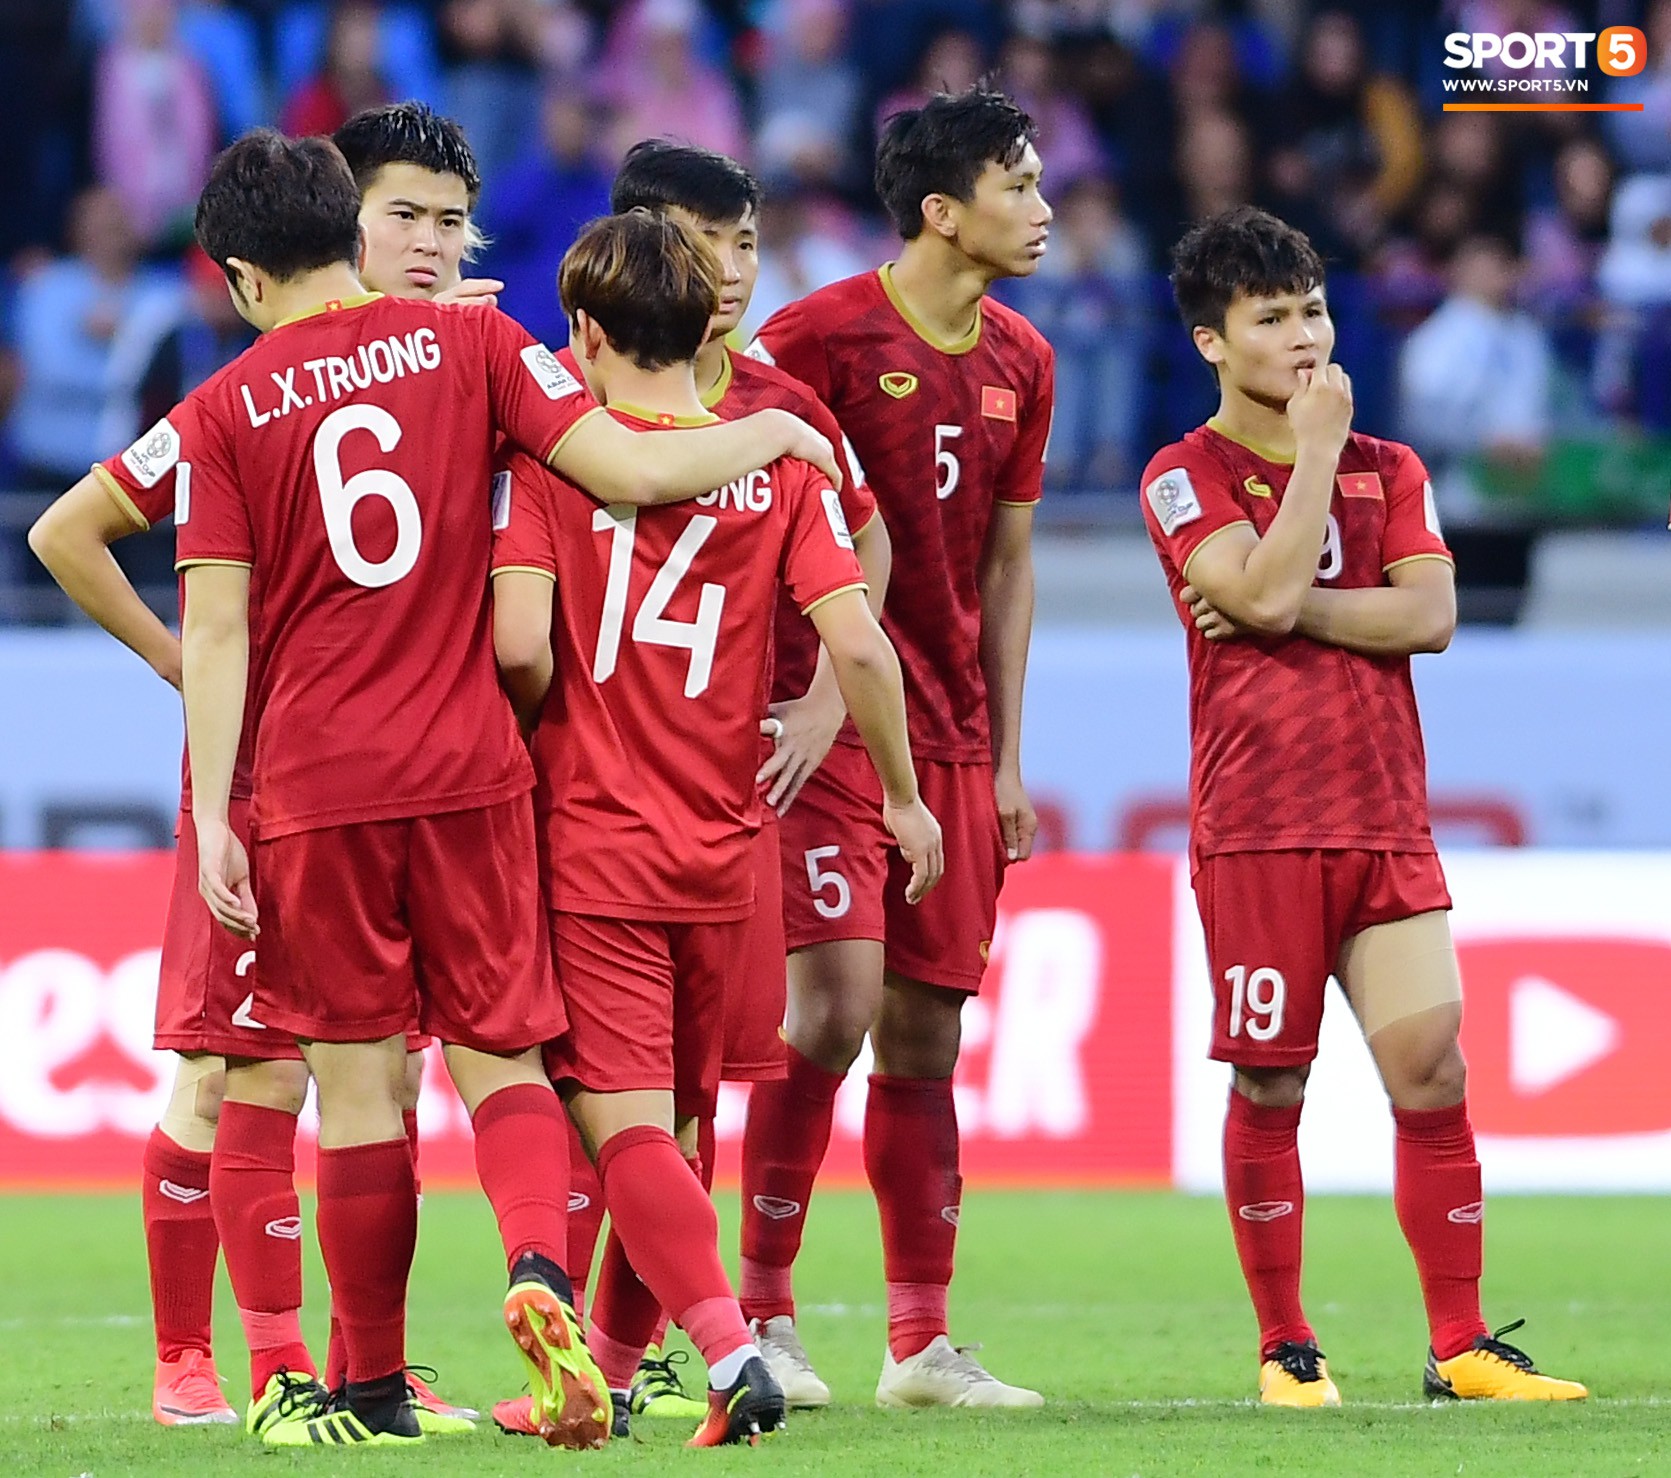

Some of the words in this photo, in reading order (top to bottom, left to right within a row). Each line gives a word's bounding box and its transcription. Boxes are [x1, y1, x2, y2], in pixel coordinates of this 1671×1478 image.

[313, 404, 423, 589] 6
[934, 424, 963, 500] 5
[592, 505, 726, 699] 14
[805, 845, 852, 919] 5
[1224, 964, 1286, 1042] 19
